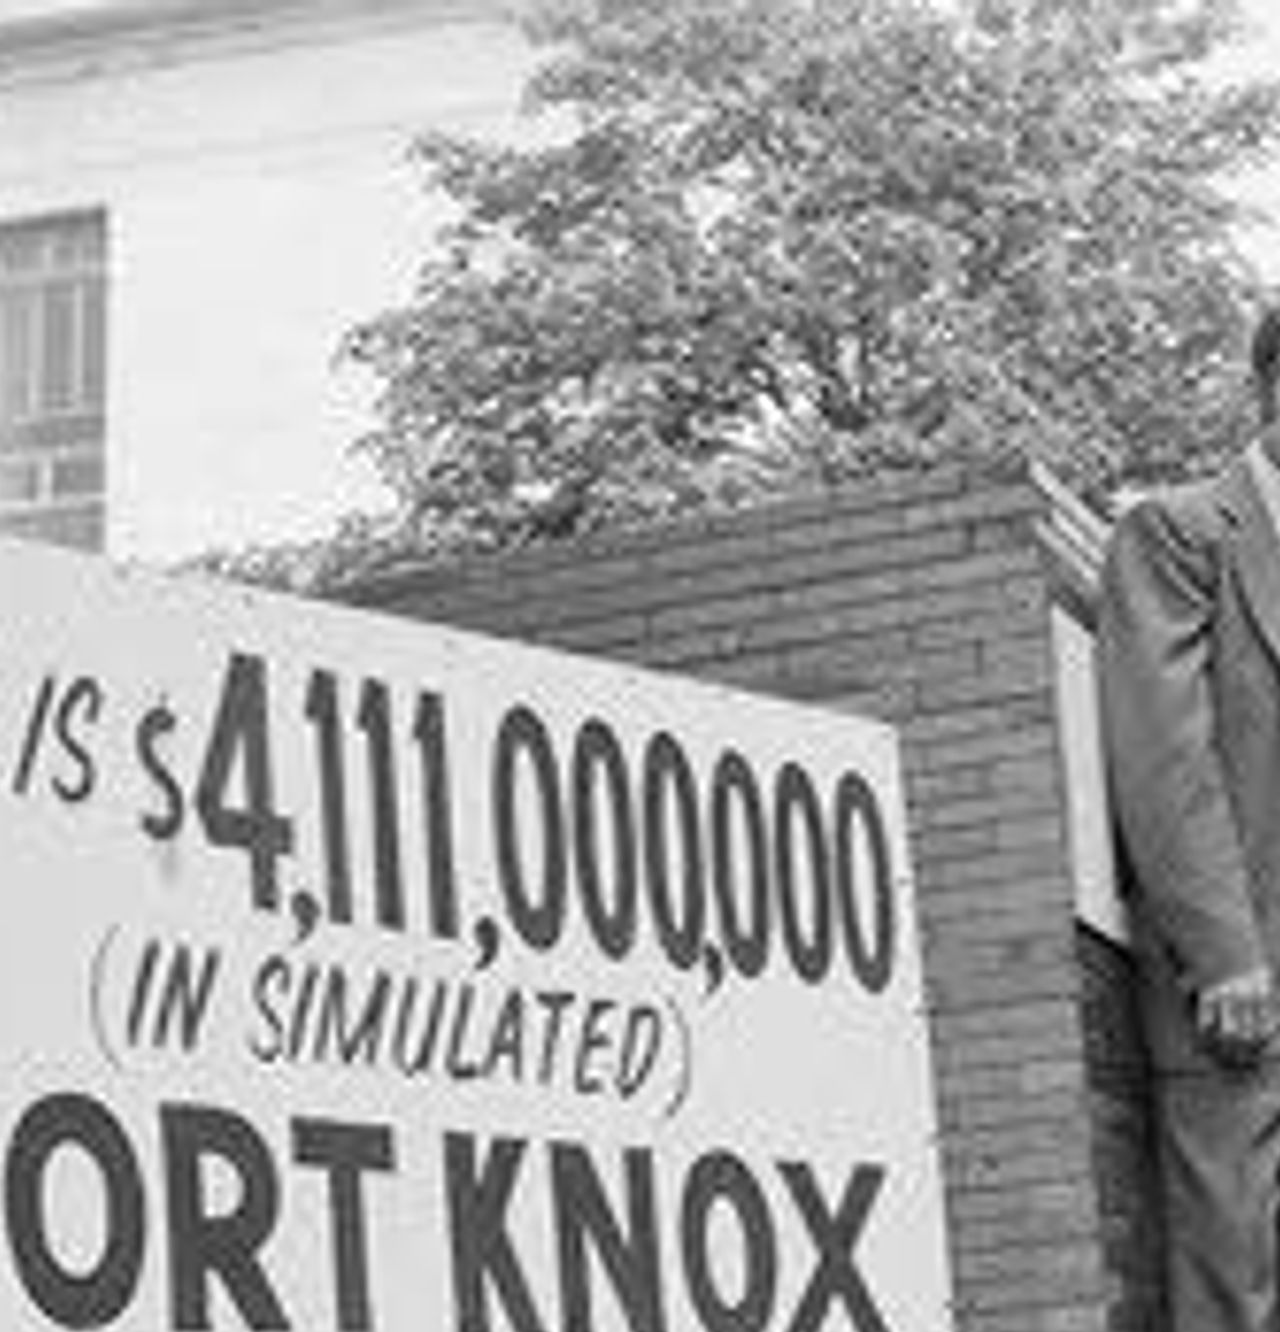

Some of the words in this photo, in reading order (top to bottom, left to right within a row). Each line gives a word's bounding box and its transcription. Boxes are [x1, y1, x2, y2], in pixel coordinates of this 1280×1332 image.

[12, 672, 106, 804] IS
[135, 651, 896, 996] $4,111,000,000
[90, 921, 222, 1071] (IN
[249, 953, 694, 1119] SIMULATED)
